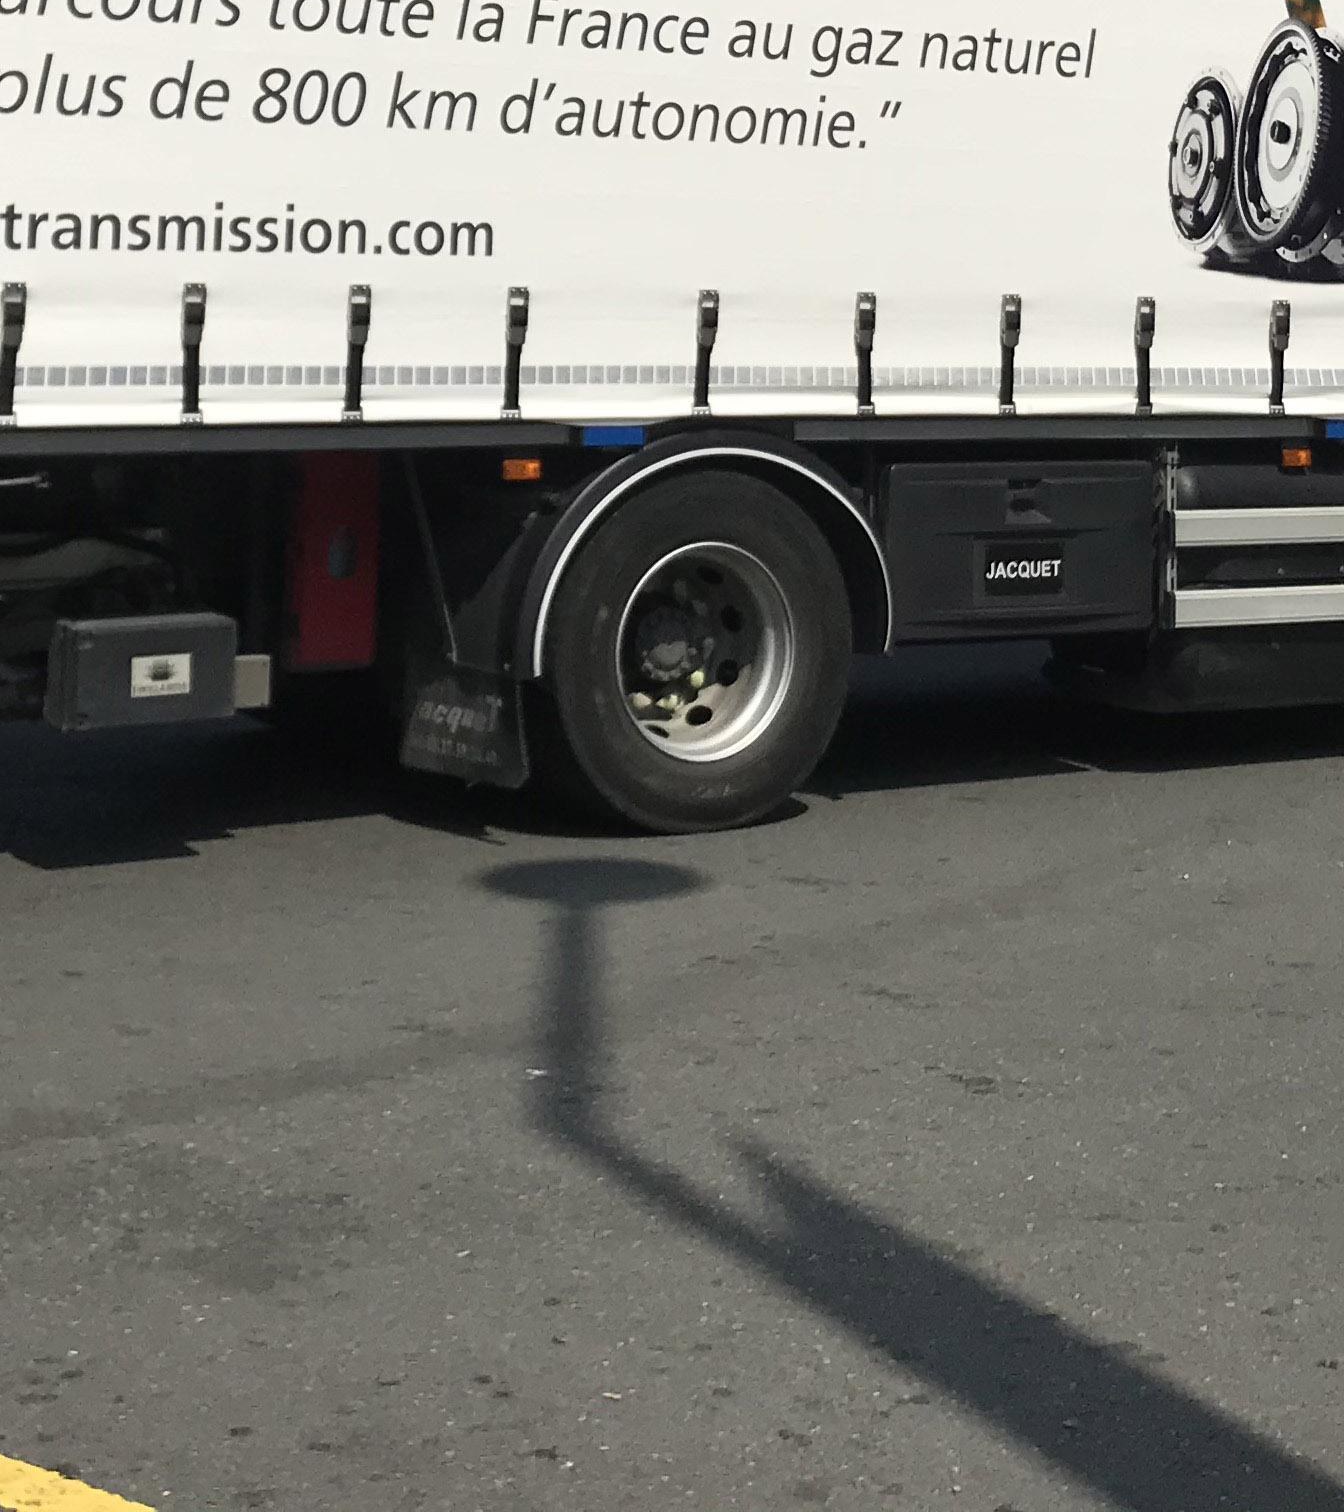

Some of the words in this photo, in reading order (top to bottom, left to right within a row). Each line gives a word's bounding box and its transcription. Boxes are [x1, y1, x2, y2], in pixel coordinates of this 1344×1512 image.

[728, 19, 793, 60] au
[810, 25, 903, 78] gaz
[919, 28, 1097, 79] naturel
[149, 59, 230, 122] de
[252, 67, 367, 127] 800
[386, 70, 478, 132] km
[985, 559, 1062, 580] JACQUET
